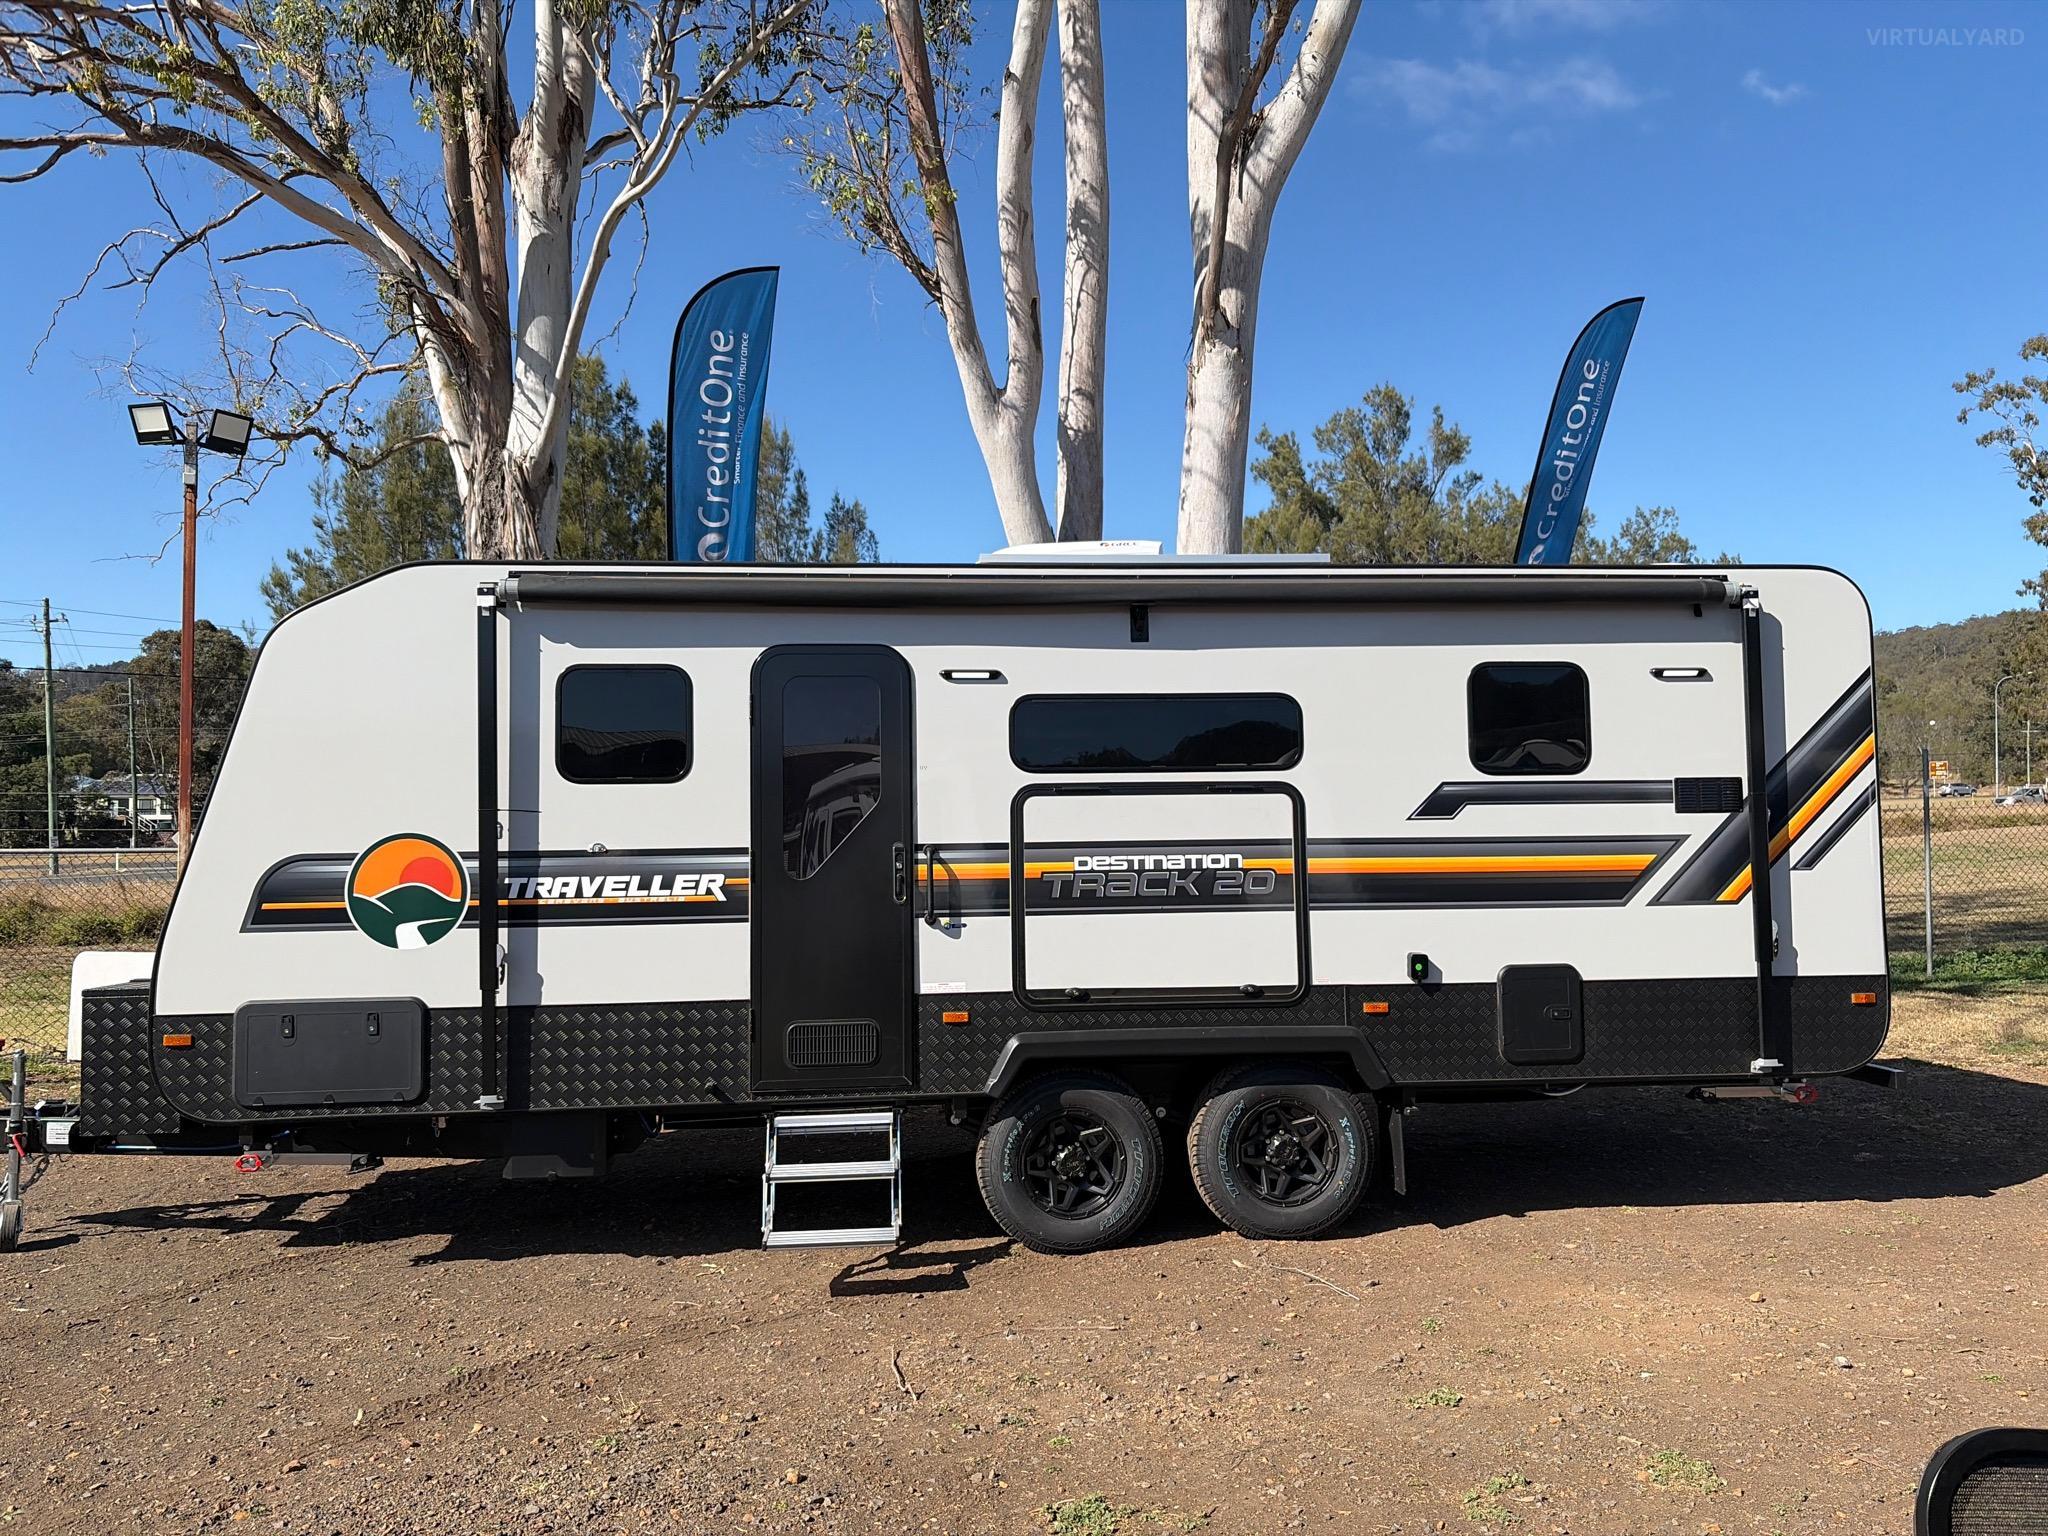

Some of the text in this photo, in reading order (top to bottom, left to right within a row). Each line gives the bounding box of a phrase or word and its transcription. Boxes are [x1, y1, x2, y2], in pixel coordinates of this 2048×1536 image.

[739, 332, 750, 384] Insurance
[737, 382, 747, 403] and
[697, 330, 734, 528] CreditOne
[1537, 358, 1601, 541] CreditOne
[504, 873, 727, 902] TRAVELLER
[1212, 869, 1276, 896] 20
